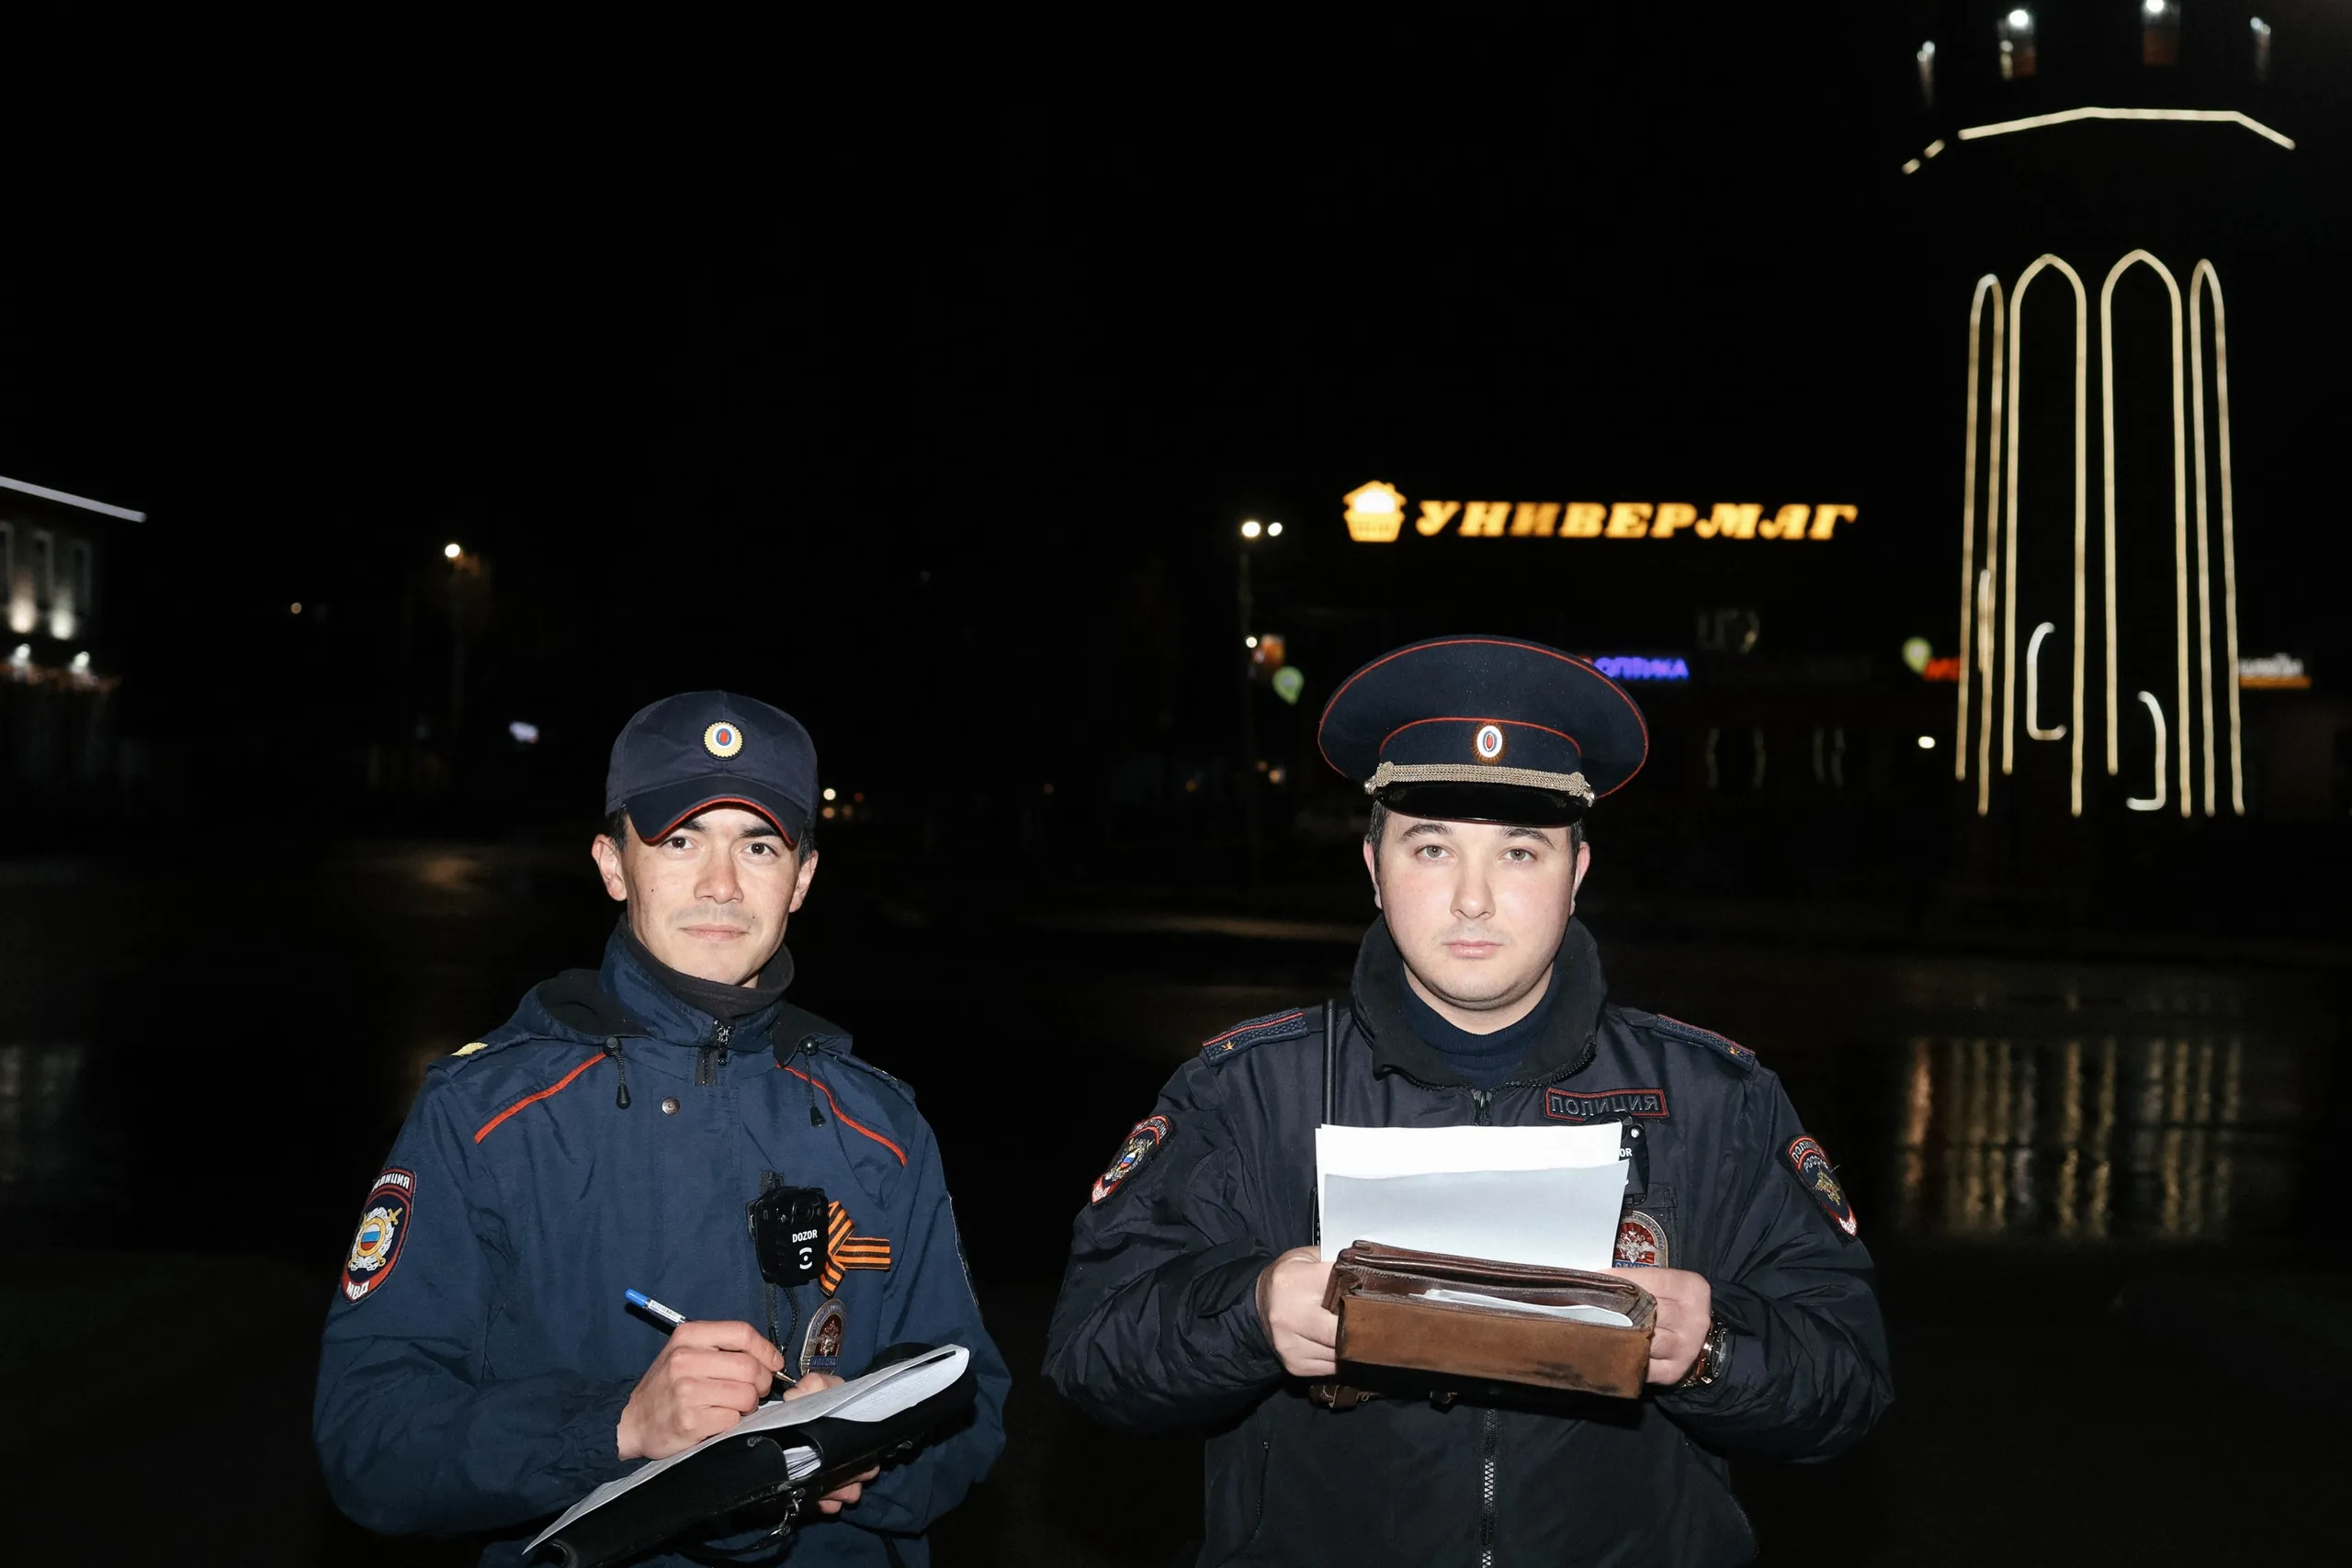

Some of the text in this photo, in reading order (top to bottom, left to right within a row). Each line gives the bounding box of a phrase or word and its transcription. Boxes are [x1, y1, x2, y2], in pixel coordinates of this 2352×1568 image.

[1416, 501, 1857, 539] УНИВЕРМАГ
[1594, 656, 1690, 681] ОПТИКА
[1551, 1095, 1659, 1116] ПОЛИЦИЯ
[792, 1229, 818, 1243] DOZOR
[346, 1280, 369, 1300] МВД
